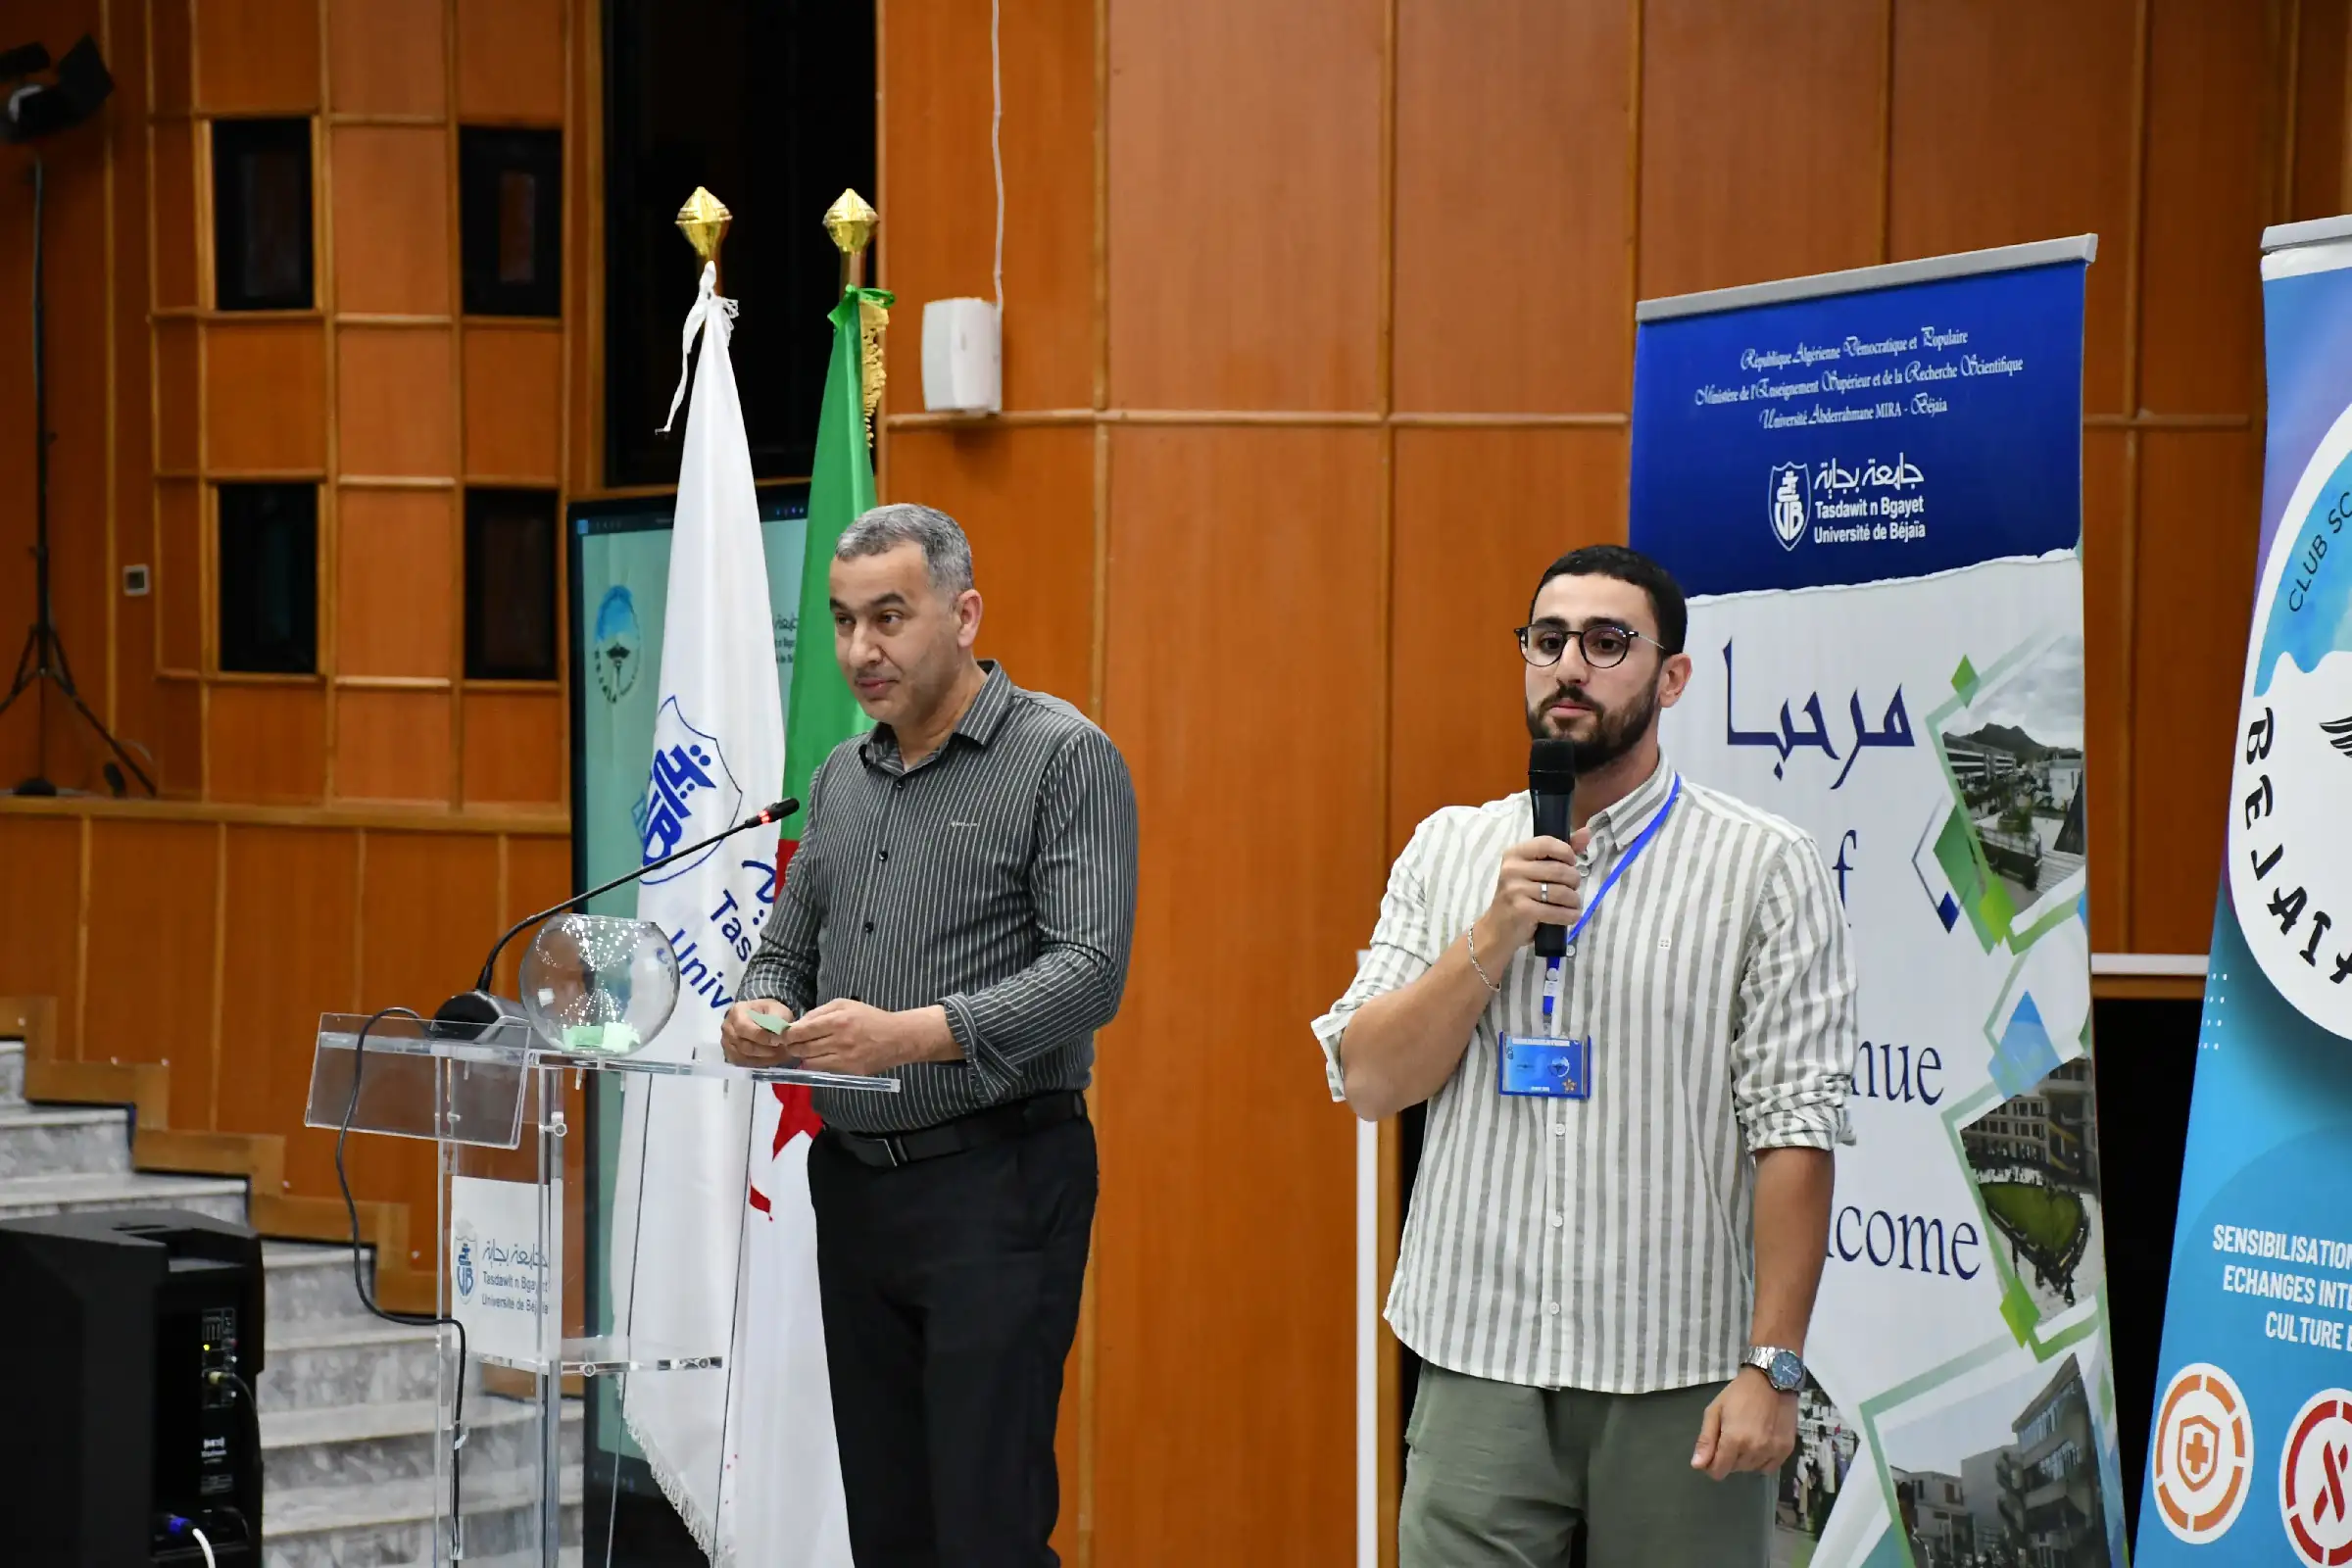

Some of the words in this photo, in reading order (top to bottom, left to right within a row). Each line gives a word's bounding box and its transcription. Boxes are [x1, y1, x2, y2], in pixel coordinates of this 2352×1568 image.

[1908, 336, 1918, 350] et
[1921, 325, 1969, 351] Populaire
[1739, 385, 1749, 401] de
[1872, 372, 1882, 387] et
[1882, 368, 1893, 386] de
[1893, 368, 1903, 385] la
[1904, 360, 1958, 384] Recherche
[1961, 354, 2024, 377] Scientifique
[1808, 403, 1874, 425] Abderrahmane
[1875, 402, 1902, 419] MIRA
[1813, 457, 1860, 500] بجاية
[1862, 451, 1925, 491] جامعة
[1815, 498, 1868, 519] Tasdawit
[1870, 501, 1879, 515] n
[1881, 495, 1925, 519] Bgayet
[1814, 522, 1871, 544] Université
[1872, 521, 1887, 541] de
[1889, 519, 1926, 543] Béjaïa
[2288, 534, 2328, 612] CLUB
[1722, 636, 1915, 790] مرحبا
[1827, 1205, 1981, 1280] come
[2223, 1264, 2316, 1305] ECHANGES
[2265, 1310, 2344, 1350] CULTURE
